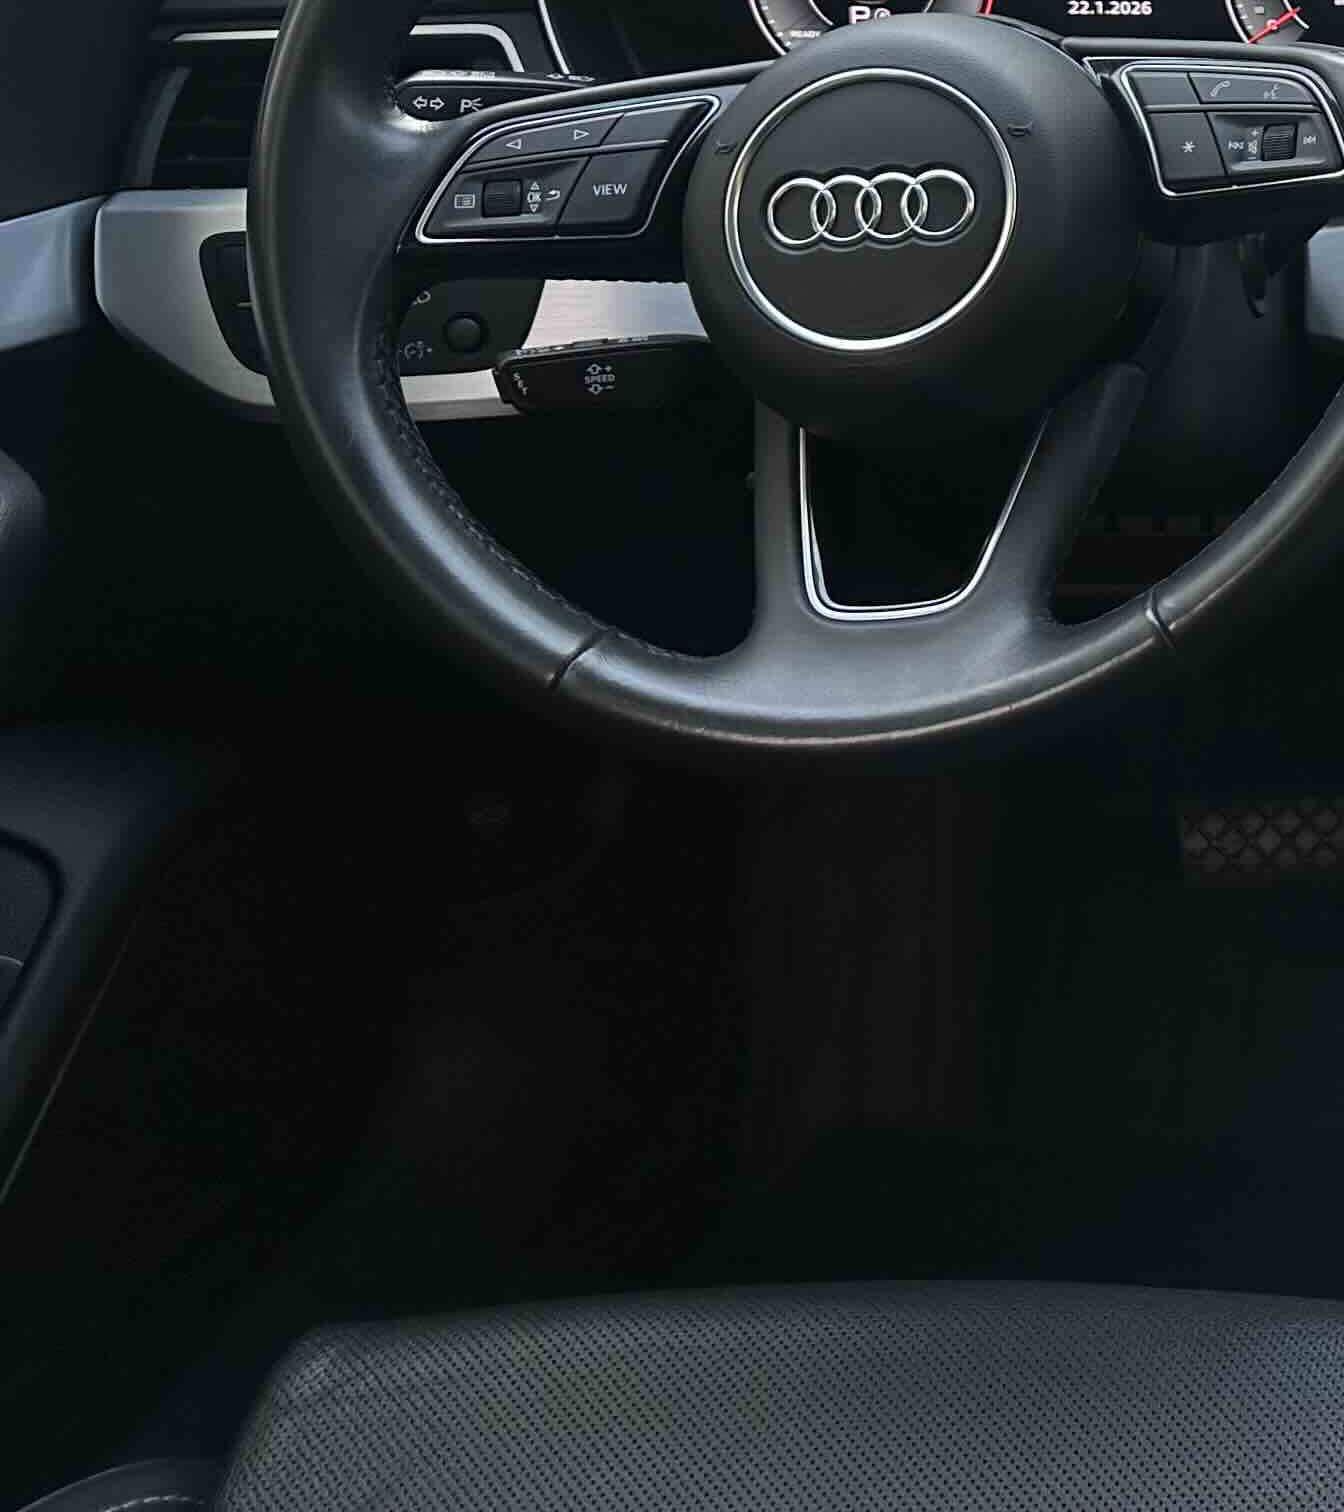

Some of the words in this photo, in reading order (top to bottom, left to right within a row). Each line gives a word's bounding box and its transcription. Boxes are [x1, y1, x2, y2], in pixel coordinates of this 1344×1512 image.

[1067, 0, 1152, 15] 22.1.2026
[593, 183, 627, 196] VIEW
[527, 191, 541, 203] OK
[584, 373, 615, 385] SPEED
